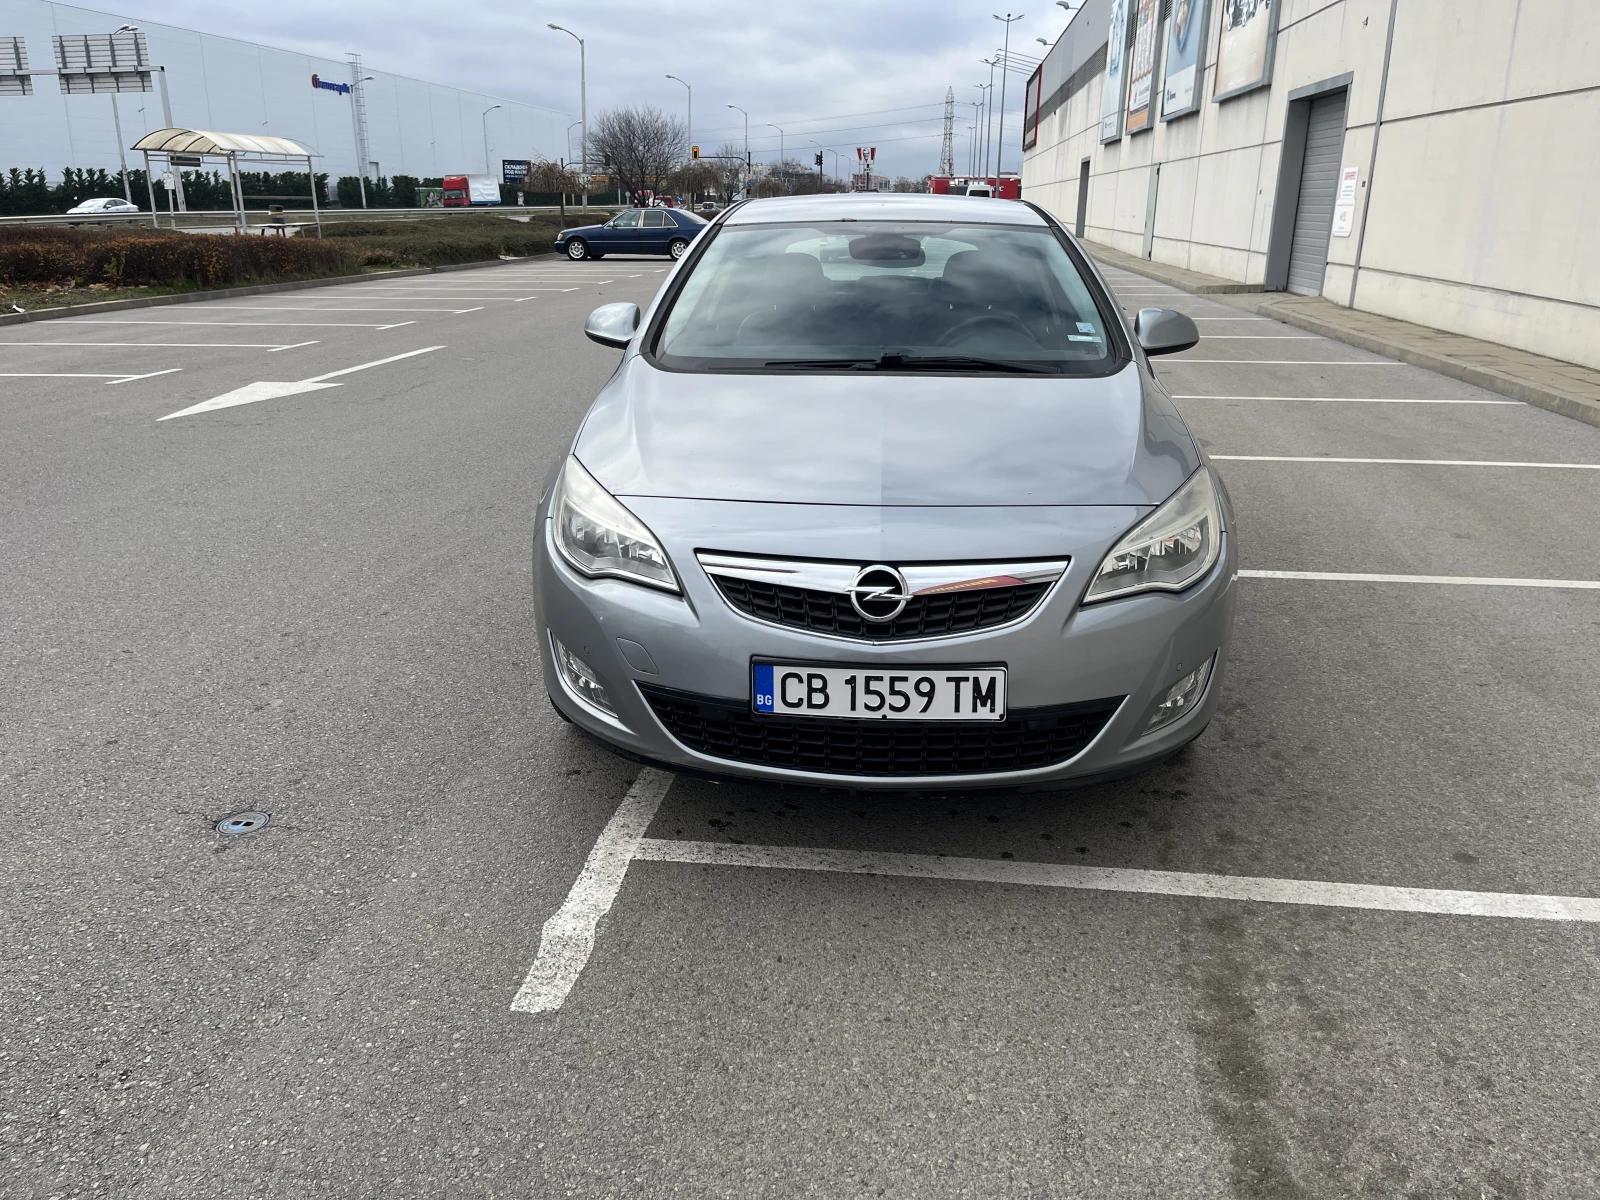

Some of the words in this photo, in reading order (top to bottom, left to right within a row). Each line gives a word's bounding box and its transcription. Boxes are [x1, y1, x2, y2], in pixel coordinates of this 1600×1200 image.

[756, 694, 773, 706] BG
[780, 671, 830, 710] CB
[844, 674, 936, 714] 1559
[945, 676, 997, 714] TM
